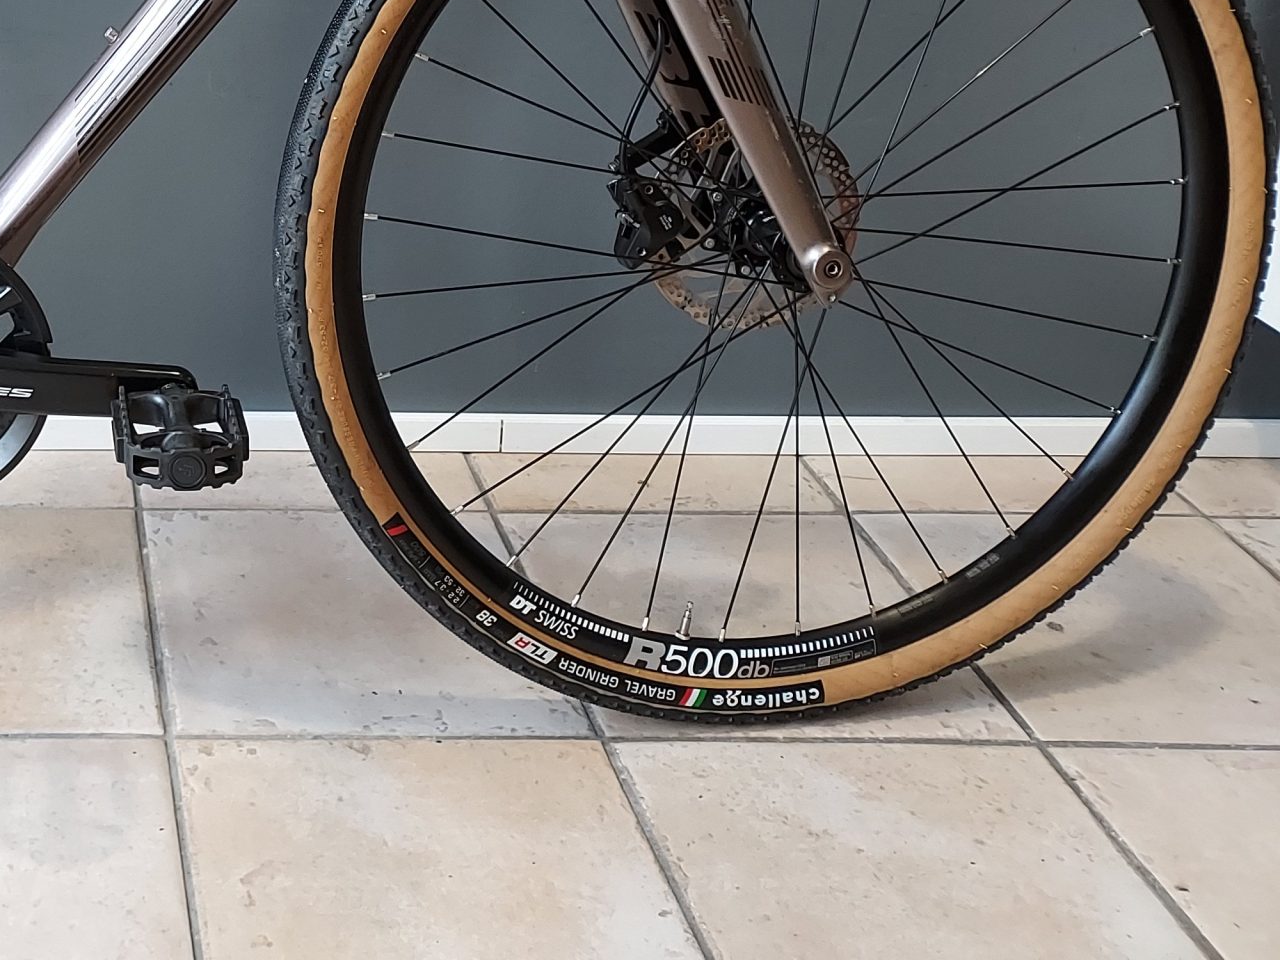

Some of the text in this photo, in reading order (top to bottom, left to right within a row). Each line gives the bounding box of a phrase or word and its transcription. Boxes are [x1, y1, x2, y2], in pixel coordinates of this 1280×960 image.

[509, 594, 579, 640] DT SWISS
[475, 609, 821, 708] challenge GRAVEL GRINDER TLR 38
